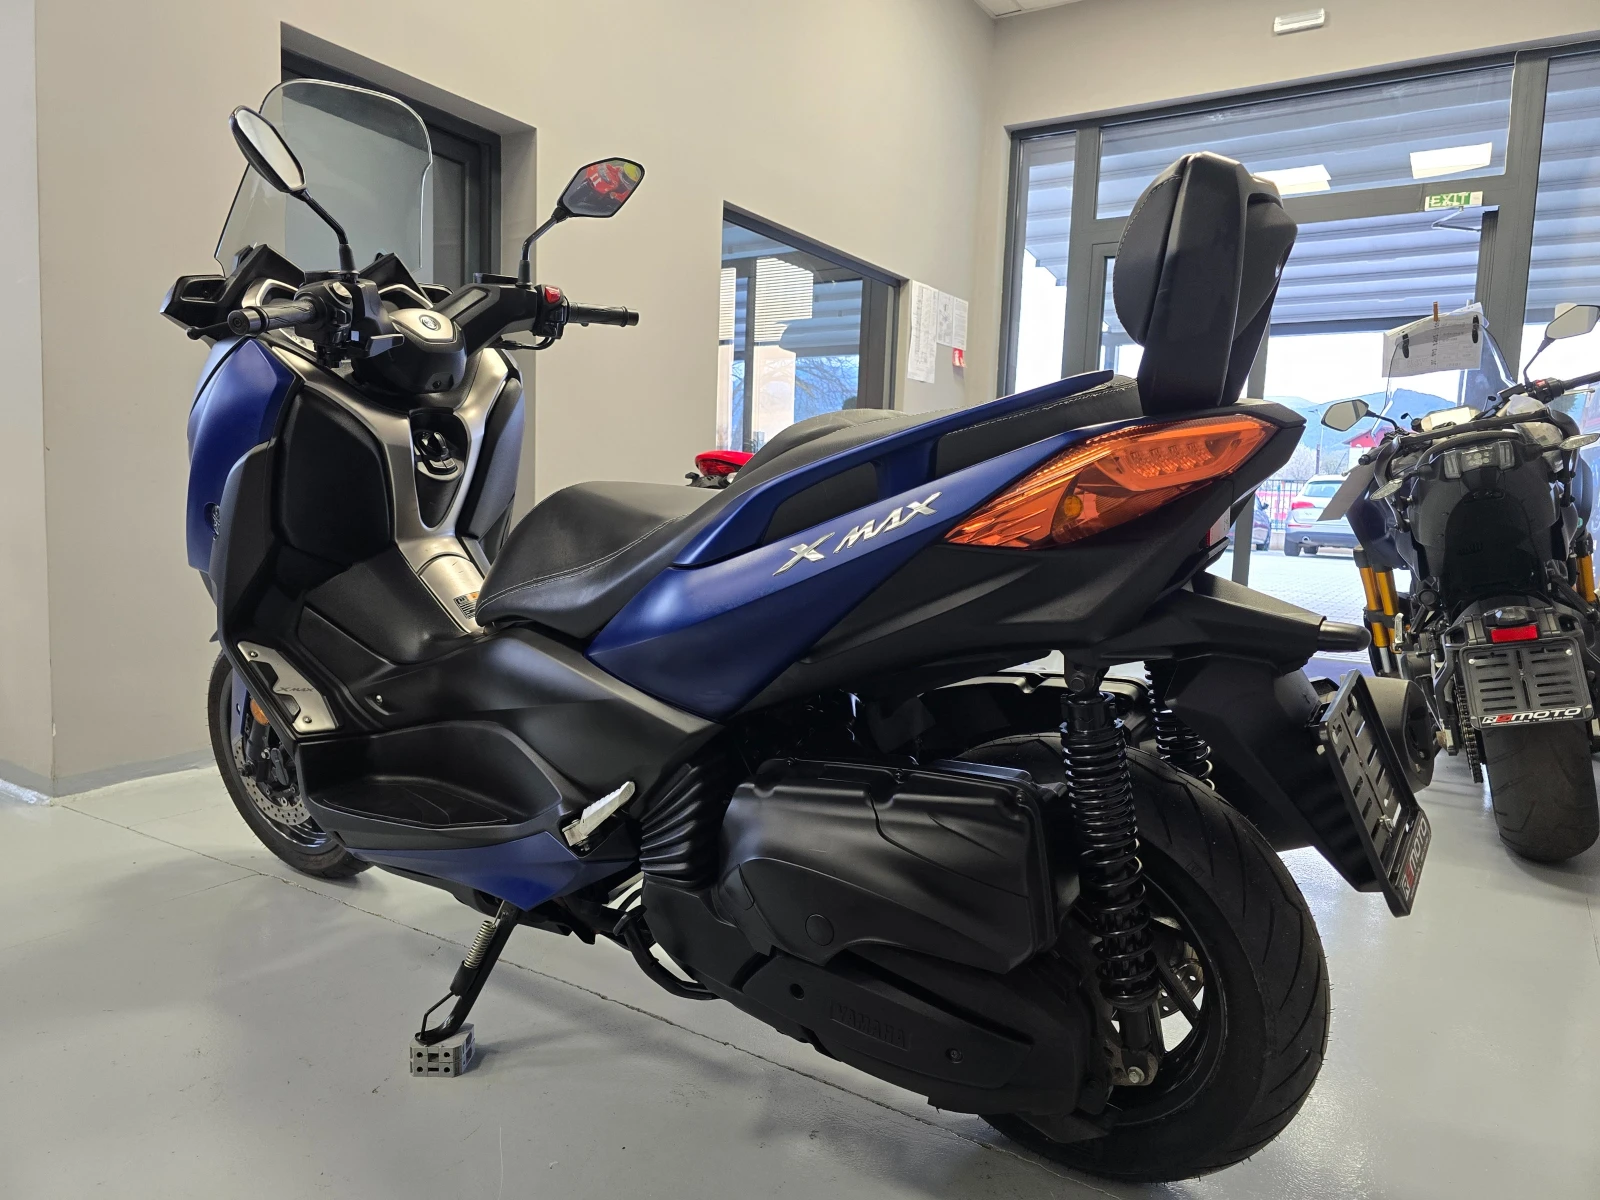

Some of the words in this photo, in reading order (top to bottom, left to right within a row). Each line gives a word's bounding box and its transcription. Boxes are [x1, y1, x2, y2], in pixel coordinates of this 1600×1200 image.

[1431, 192, 1470, 207] EXIT
[772, 532, 836, 576] X
[832, 491, 943, 554] MAX
[837, 1002, 906, 1048] YAMAHA
